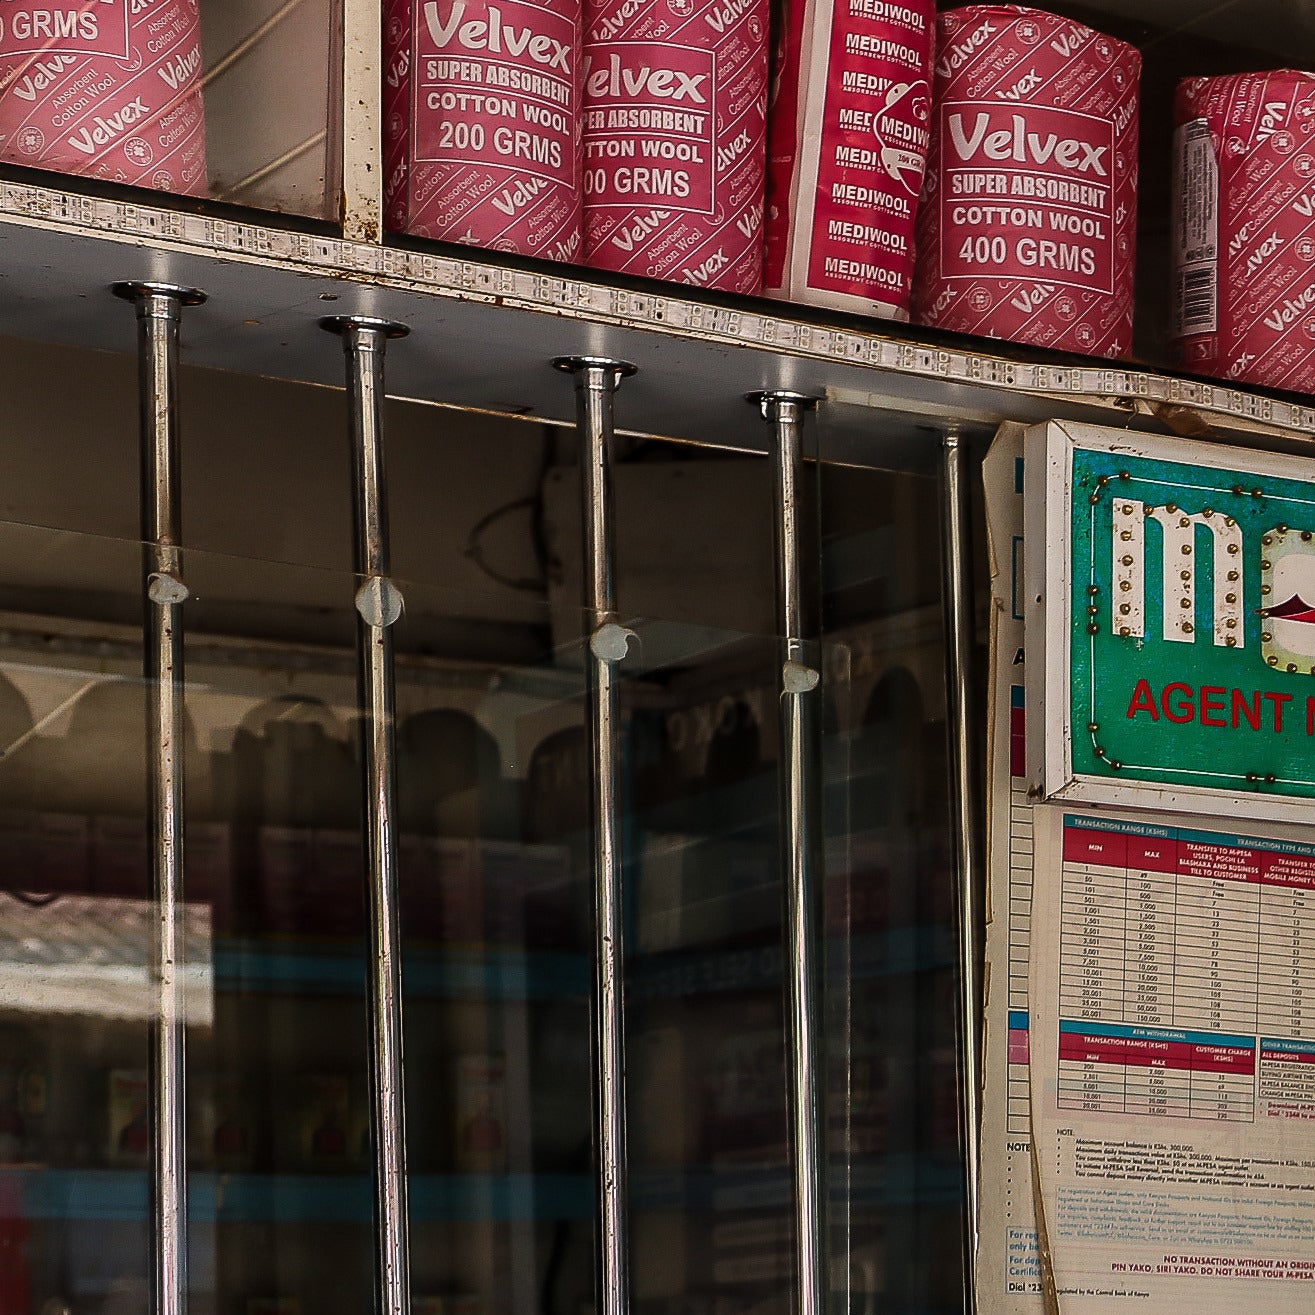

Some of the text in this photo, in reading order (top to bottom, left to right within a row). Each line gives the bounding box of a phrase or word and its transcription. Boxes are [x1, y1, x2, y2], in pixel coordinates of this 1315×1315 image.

[11, 8, 99, 41] GRMS
[424, 0, 573, 74] Velvex
[426, 60, 571, 105] SUPER ABSORBENT
[427, 92, 570, 136] COTTON WOOL
[439, 120, 562, 168] 200 GRMS
[948, 111, 1108, 177] Velvex
[951, 172, 1107, 210] SUPER ABSORBENT
[952, 206, 1106, 242] COTTON WOOL
[823, 255, 904, 288] MEDIWOOL
[958, 237, 1097, 277] 400 GRMS
[1127, 678, 1300, 732] AGENT
[1164, 1256, 1177, 1264] NO
[1180, 1256, 1235, 1266] TRANSACTION
[1237, 1259, 1273, 1268] WITHOUT
[1276, 1260, 1287, 1268] AN
